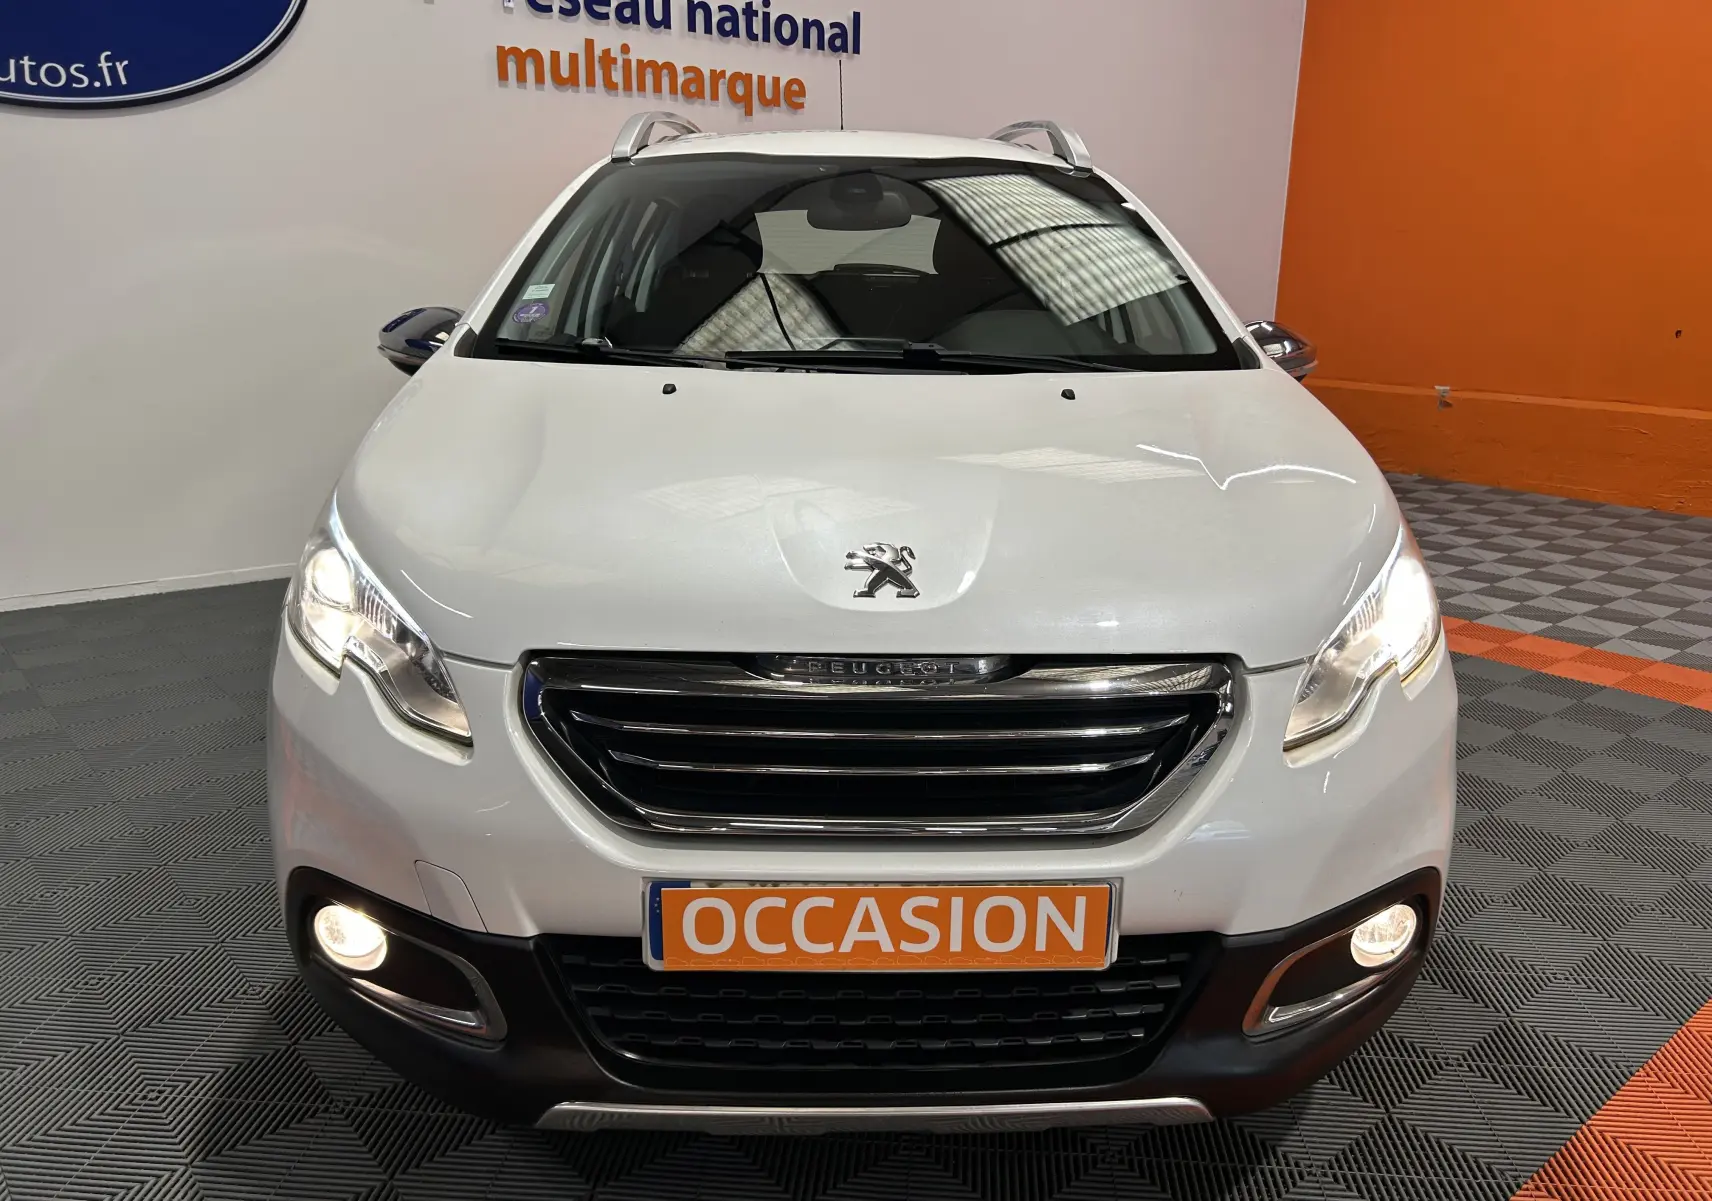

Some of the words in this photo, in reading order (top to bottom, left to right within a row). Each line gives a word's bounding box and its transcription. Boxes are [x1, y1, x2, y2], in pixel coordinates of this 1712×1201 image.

[504, 0, 671, 30] seau
[687, 0, 861, 55] national
[496, 38, 807, 117] multimarque
[808, 660, 961, 675] PEUGEOT
[682, 895, 1088, 956] OCCASION
